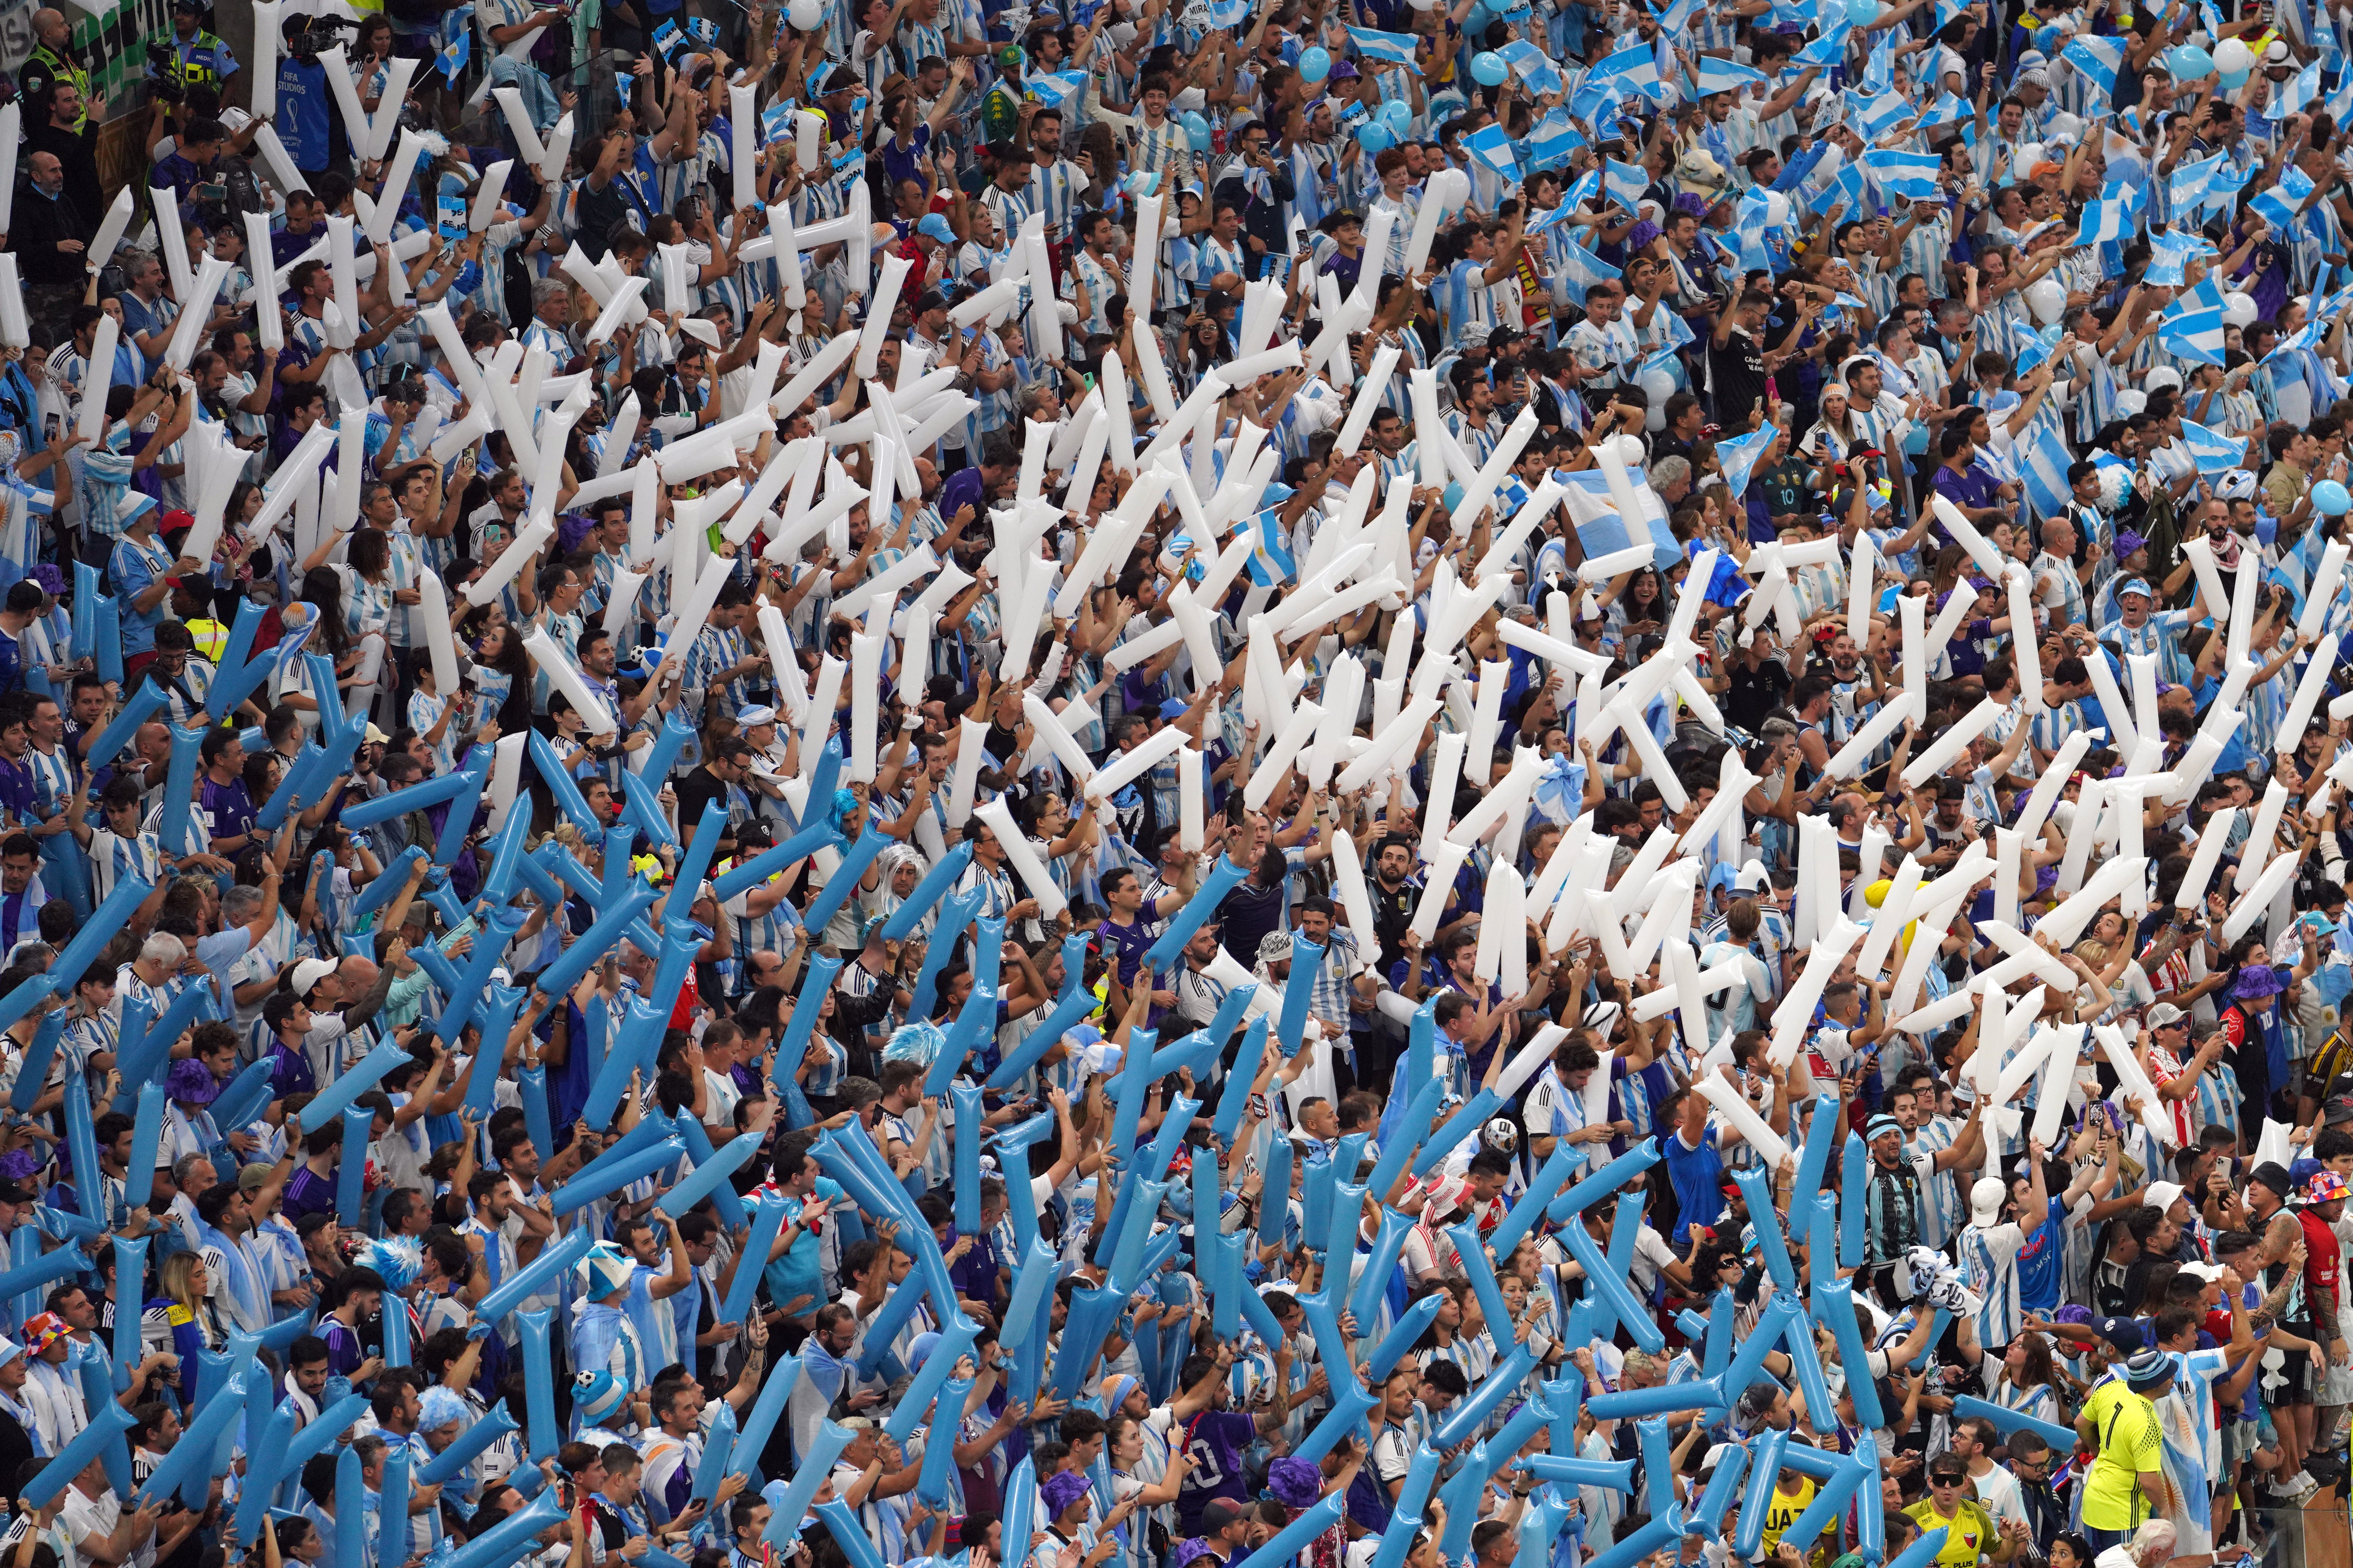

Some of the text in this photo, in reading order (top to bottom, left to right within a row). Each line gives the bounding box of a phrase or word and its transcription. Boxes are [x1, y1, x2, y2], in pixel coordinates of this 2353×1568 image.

[284, 71, 298, 82] FIFA
[277, 81, 305, 95] STUDIOS
[1629, 340, 1638, 354] 10
[1780, 488, 1794, 505] 10
[144, 557, 163, 575] 10
[2310, 716, 2320, 725] NY
[2259, 1010, 2274, 1031] 10
[837, 1059, 845, 1078] 10
[2221, 1098, 2233, 1117] 8
[2036, 1250, 2052, 1271] MSC
[2105, 1401, 2124, 1451] 1
